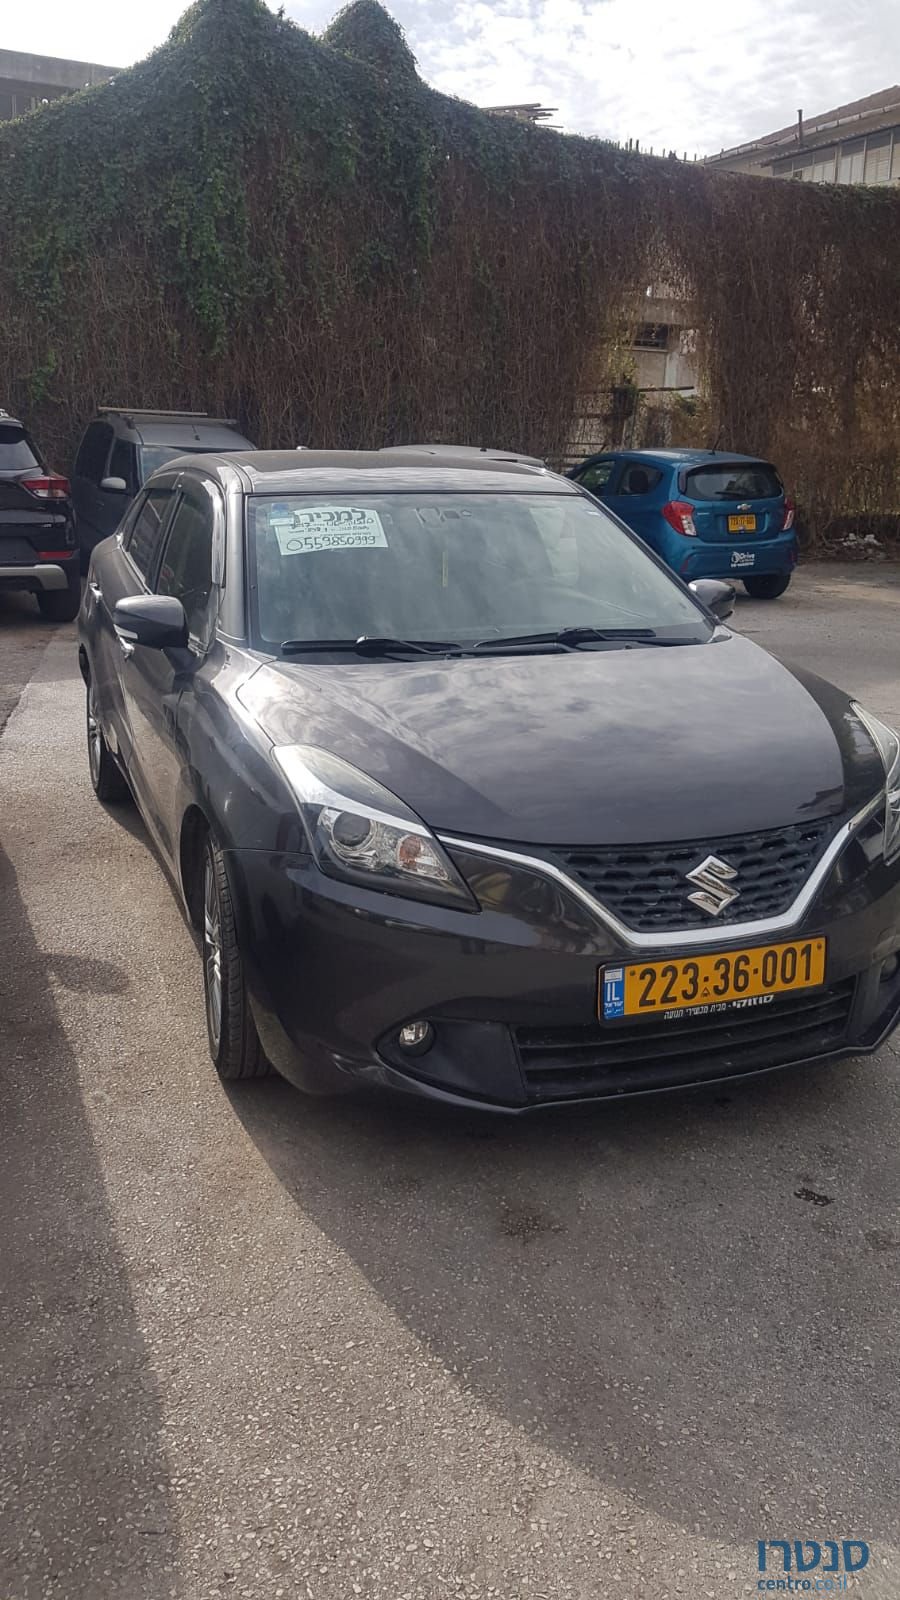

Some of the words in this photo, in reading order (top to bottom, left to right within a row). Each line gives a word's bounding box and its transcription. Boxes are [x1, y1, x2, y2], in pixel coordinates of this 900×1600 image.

[286, 535, 376, 551] 0559850999
[607, 982, 621, 1002] IL
[732, 994, 775, 1009] סוזוקי
